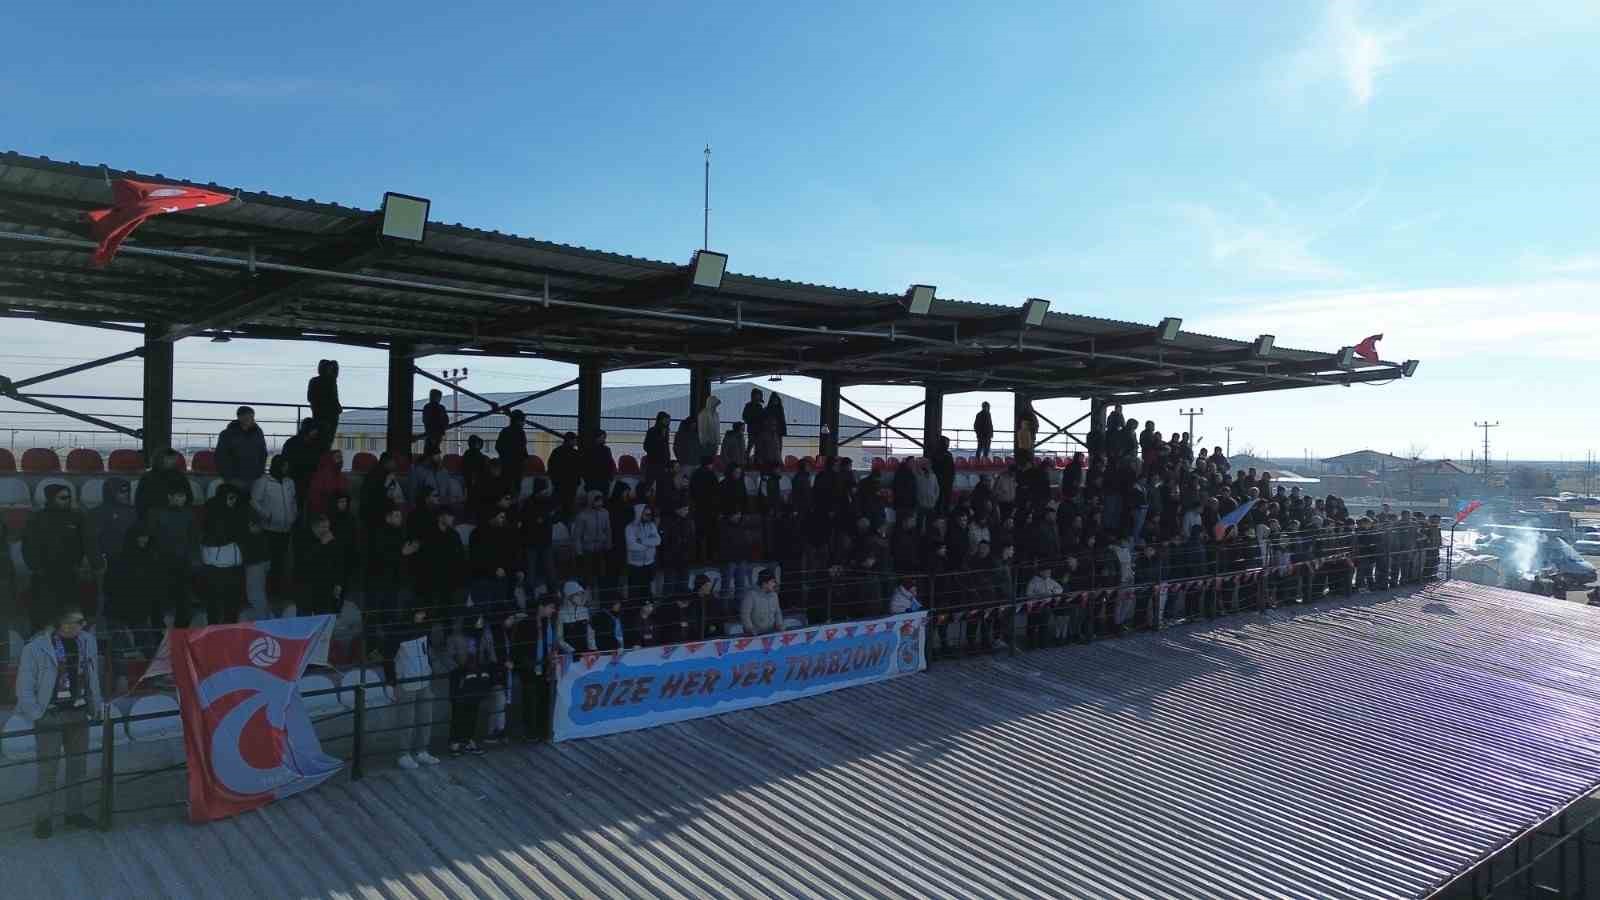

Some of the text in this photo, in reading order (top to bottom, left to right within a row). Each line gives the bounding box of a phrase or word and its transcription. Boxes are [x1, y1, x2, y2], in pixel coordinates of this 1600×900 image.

[582, 674, 655, 711] BİZE
[660, 669, 721, 699] HER
[728, 661, 776, 689] YER
